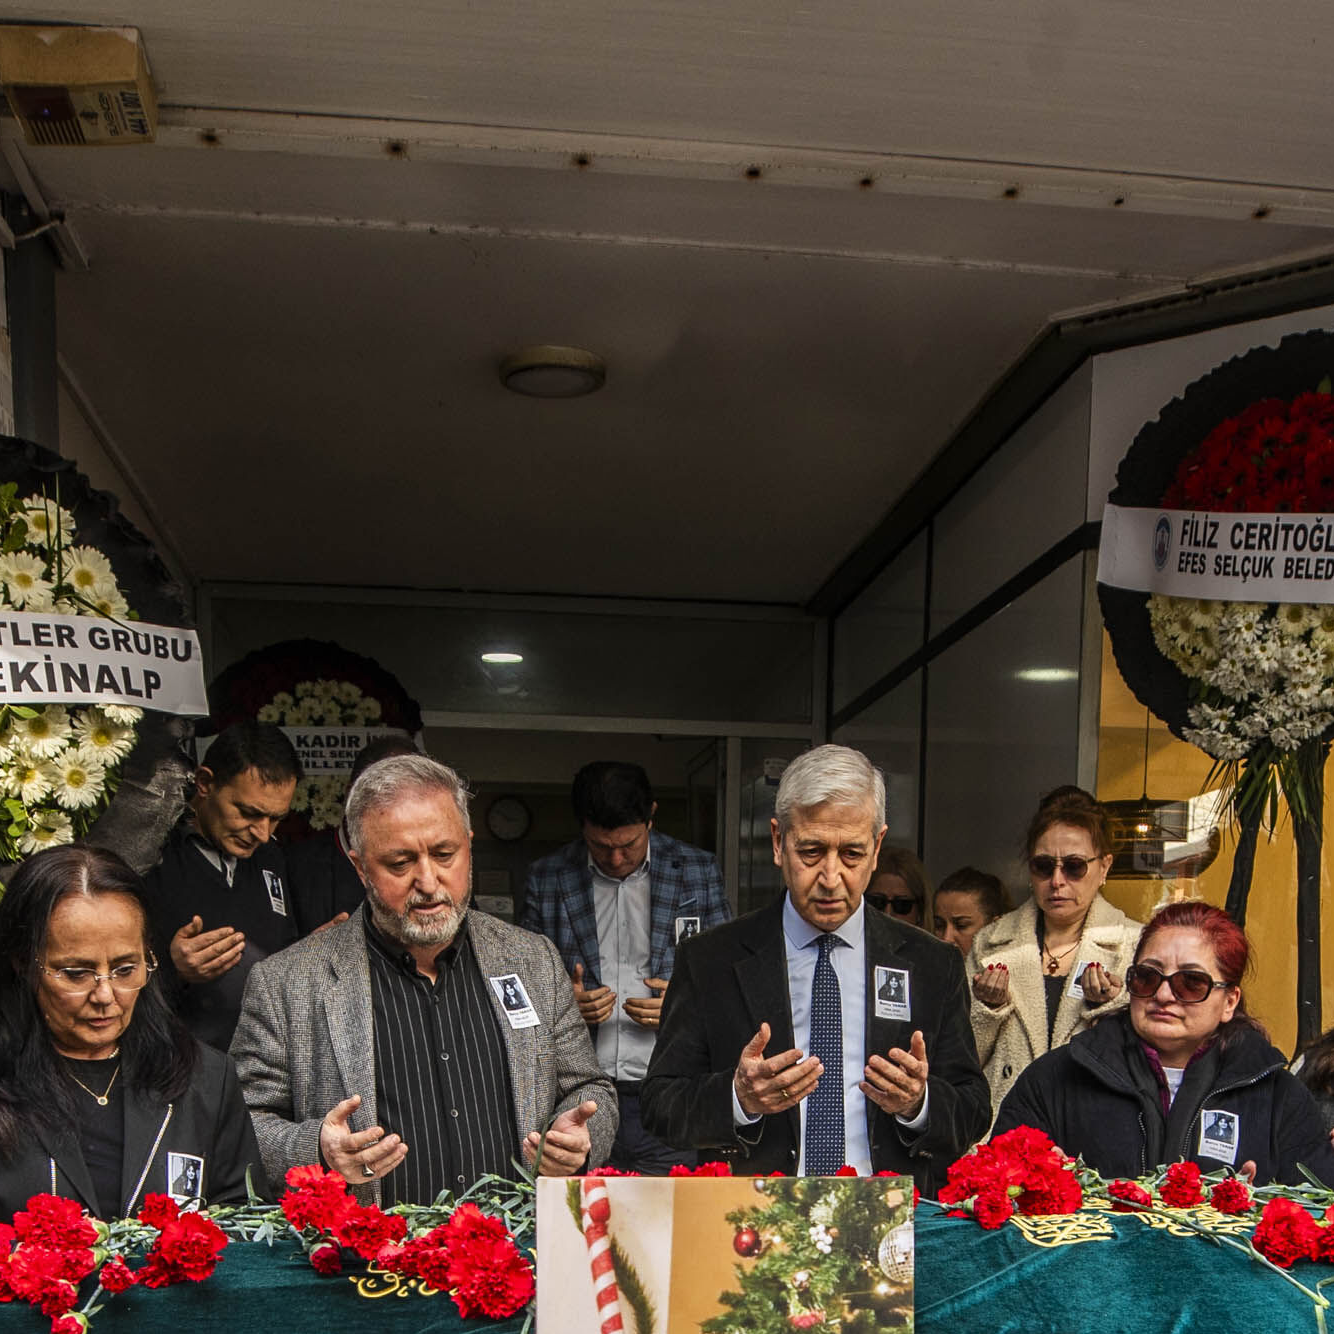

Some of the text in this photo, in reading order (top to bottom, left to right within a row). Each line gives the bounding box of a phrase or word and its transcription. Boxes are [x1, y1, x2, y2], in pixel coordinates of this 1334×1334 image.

[1179, 513, 1220, 549] FİLİZ
[1177, 551, 1207, 576] EFES
[1213, 554, 1275, 583] SELÇUK
[88, 626, 192, 663] GRUBU
[296, 732, 361, 748] KADİR
